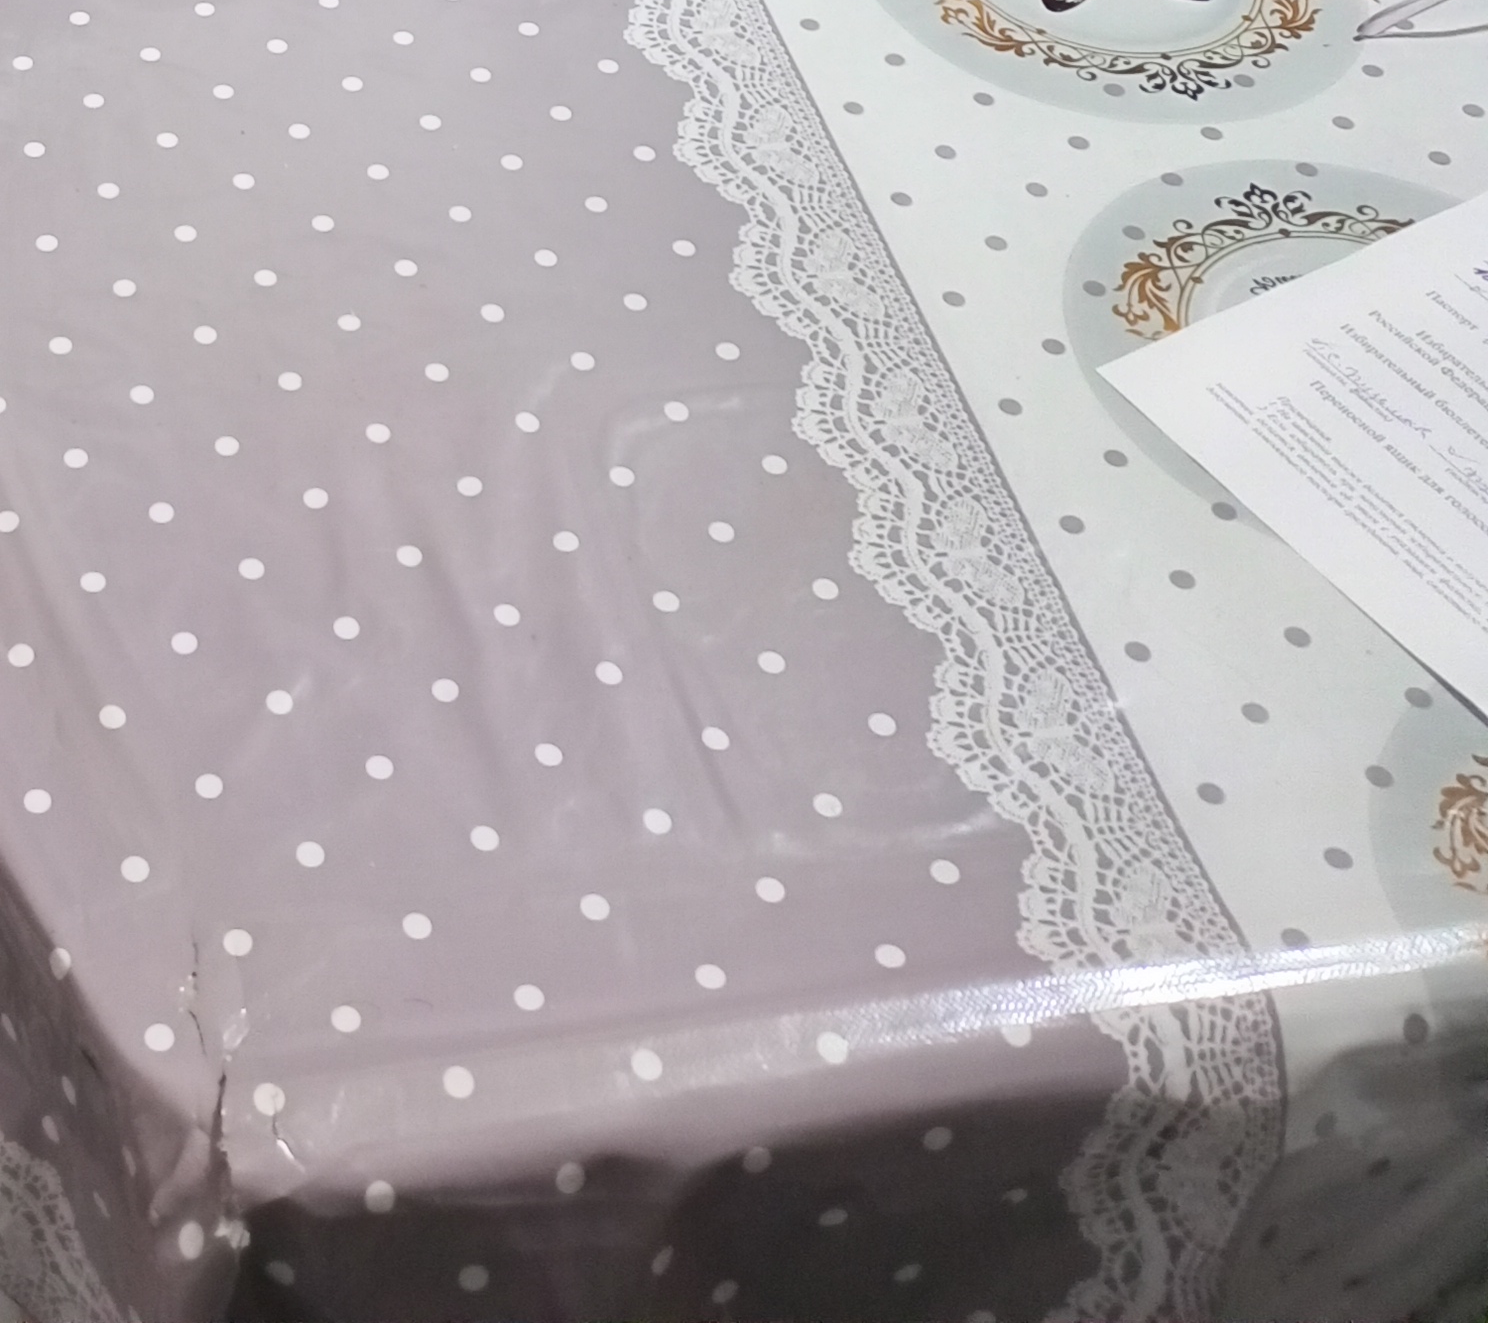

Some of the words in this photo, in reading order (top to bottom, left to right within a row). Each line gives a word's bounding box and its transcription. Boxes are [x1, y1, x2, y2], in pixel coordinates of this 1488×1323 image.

[1368, 310, 1440, 365] Российской
[1425, 290, 1478, 329] Паспорт
[1340, 323, 1436, 399] Избирательный
[1307, 379, 1387, 442] Переносной
[1381, 443, 1421, 474] ящик
[1416, 474, 1447, 494] для
